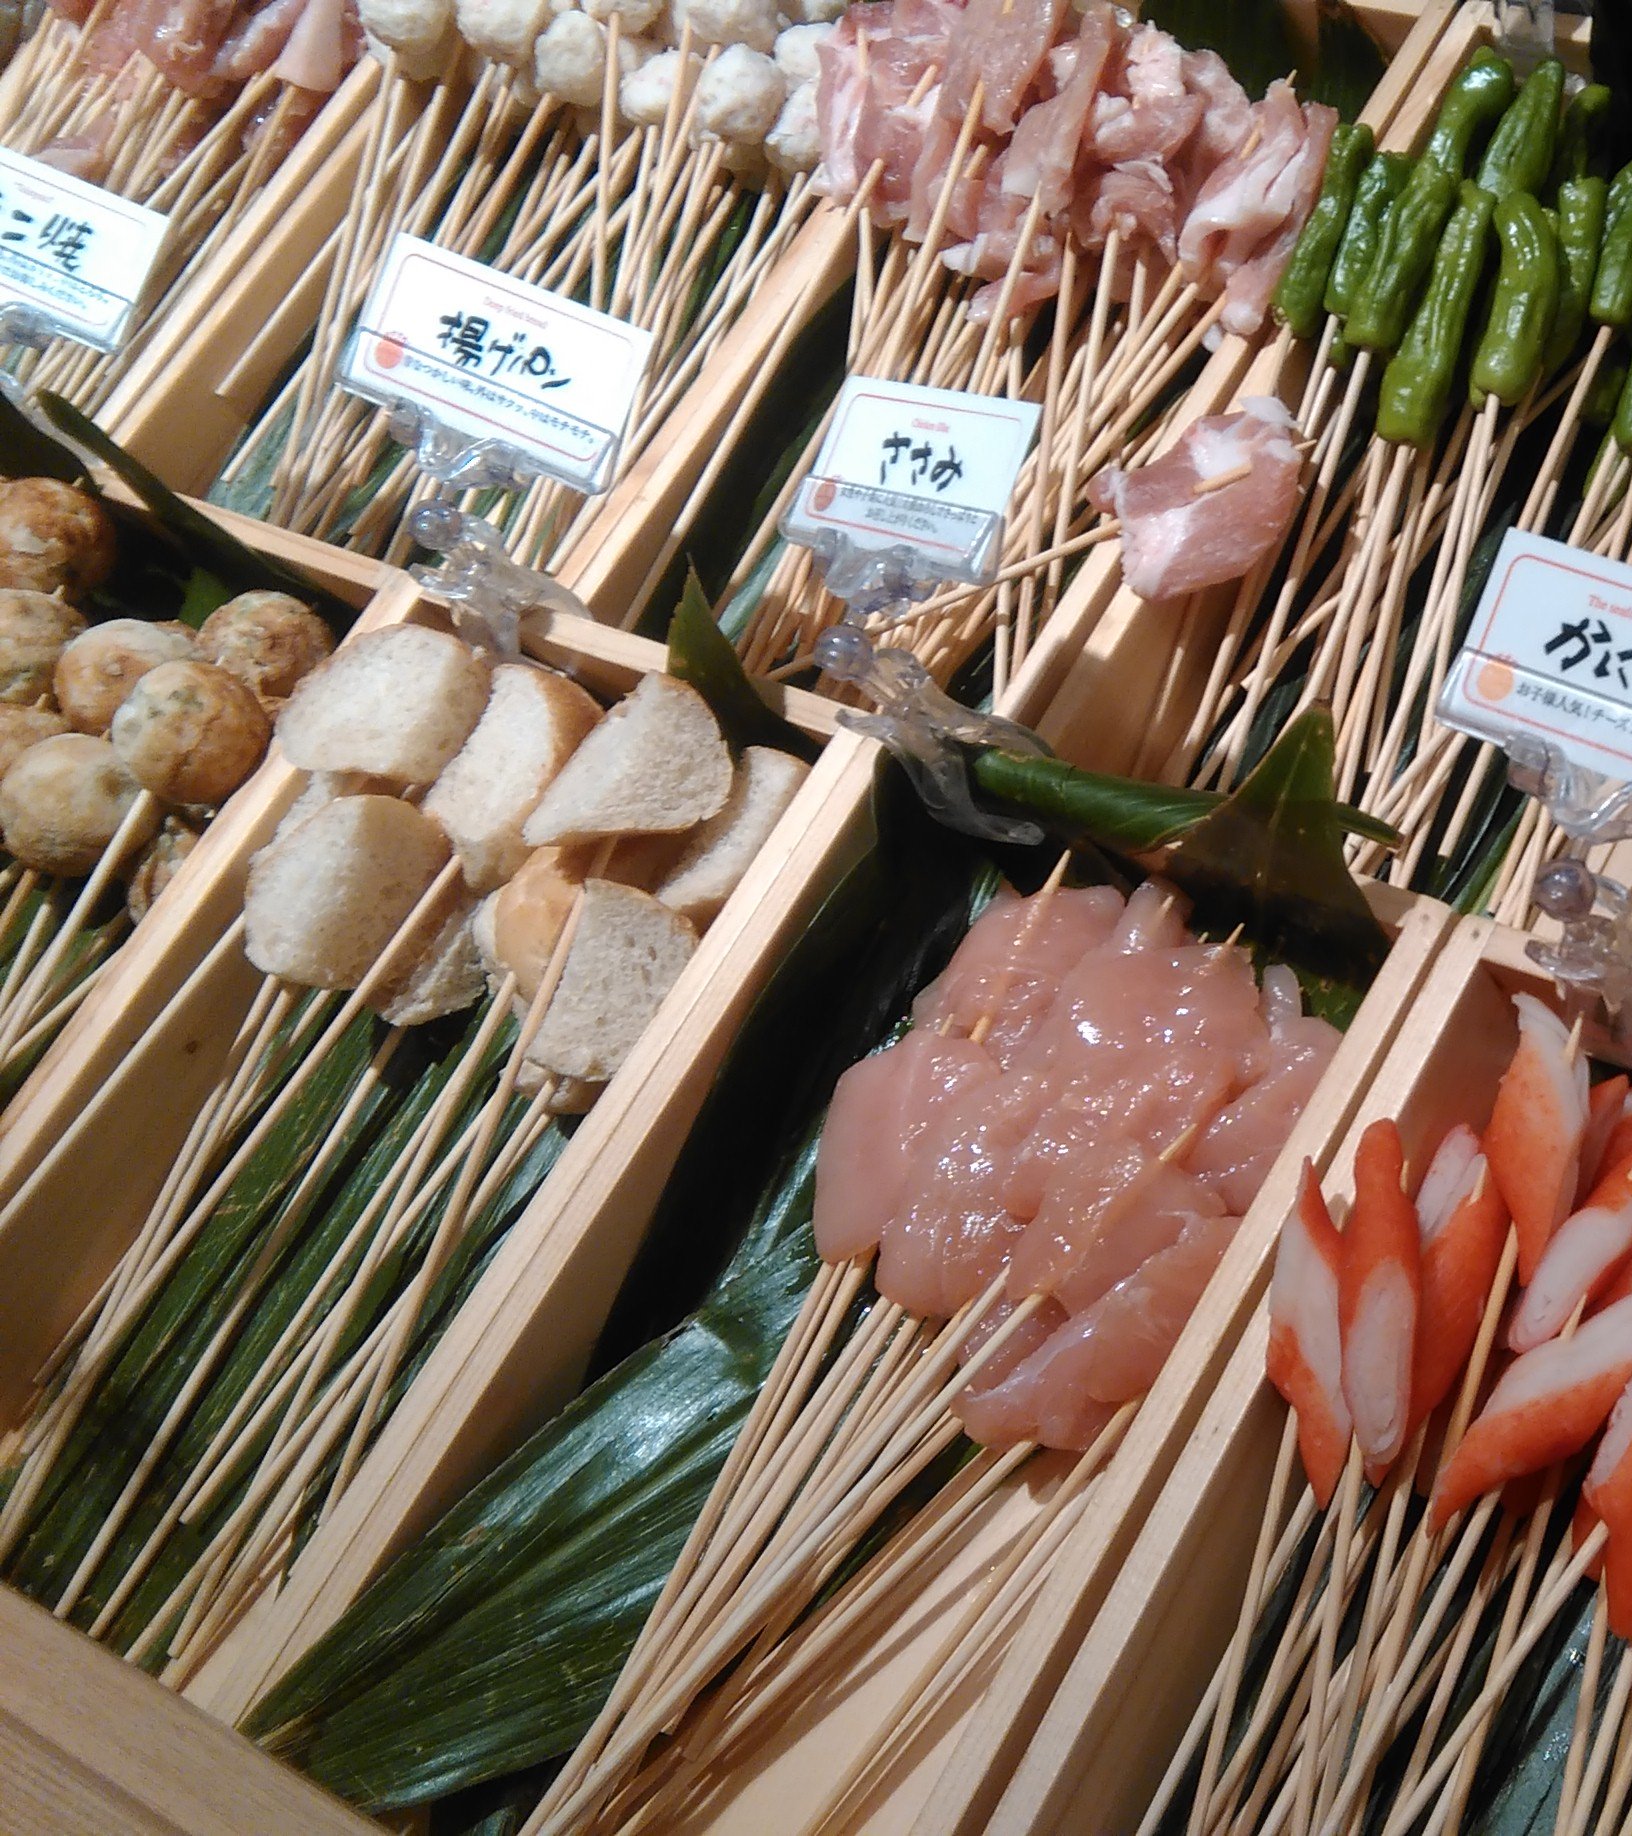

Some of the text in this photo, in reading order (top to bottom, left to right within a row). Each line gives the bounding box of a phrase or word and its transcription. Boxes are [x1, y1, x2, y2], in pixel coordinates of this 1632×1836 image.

[436, 311, 571, 390] 揚げパン
[879, 431, 963, 492] ささみ
[1587, 594, 1609, 611] The
